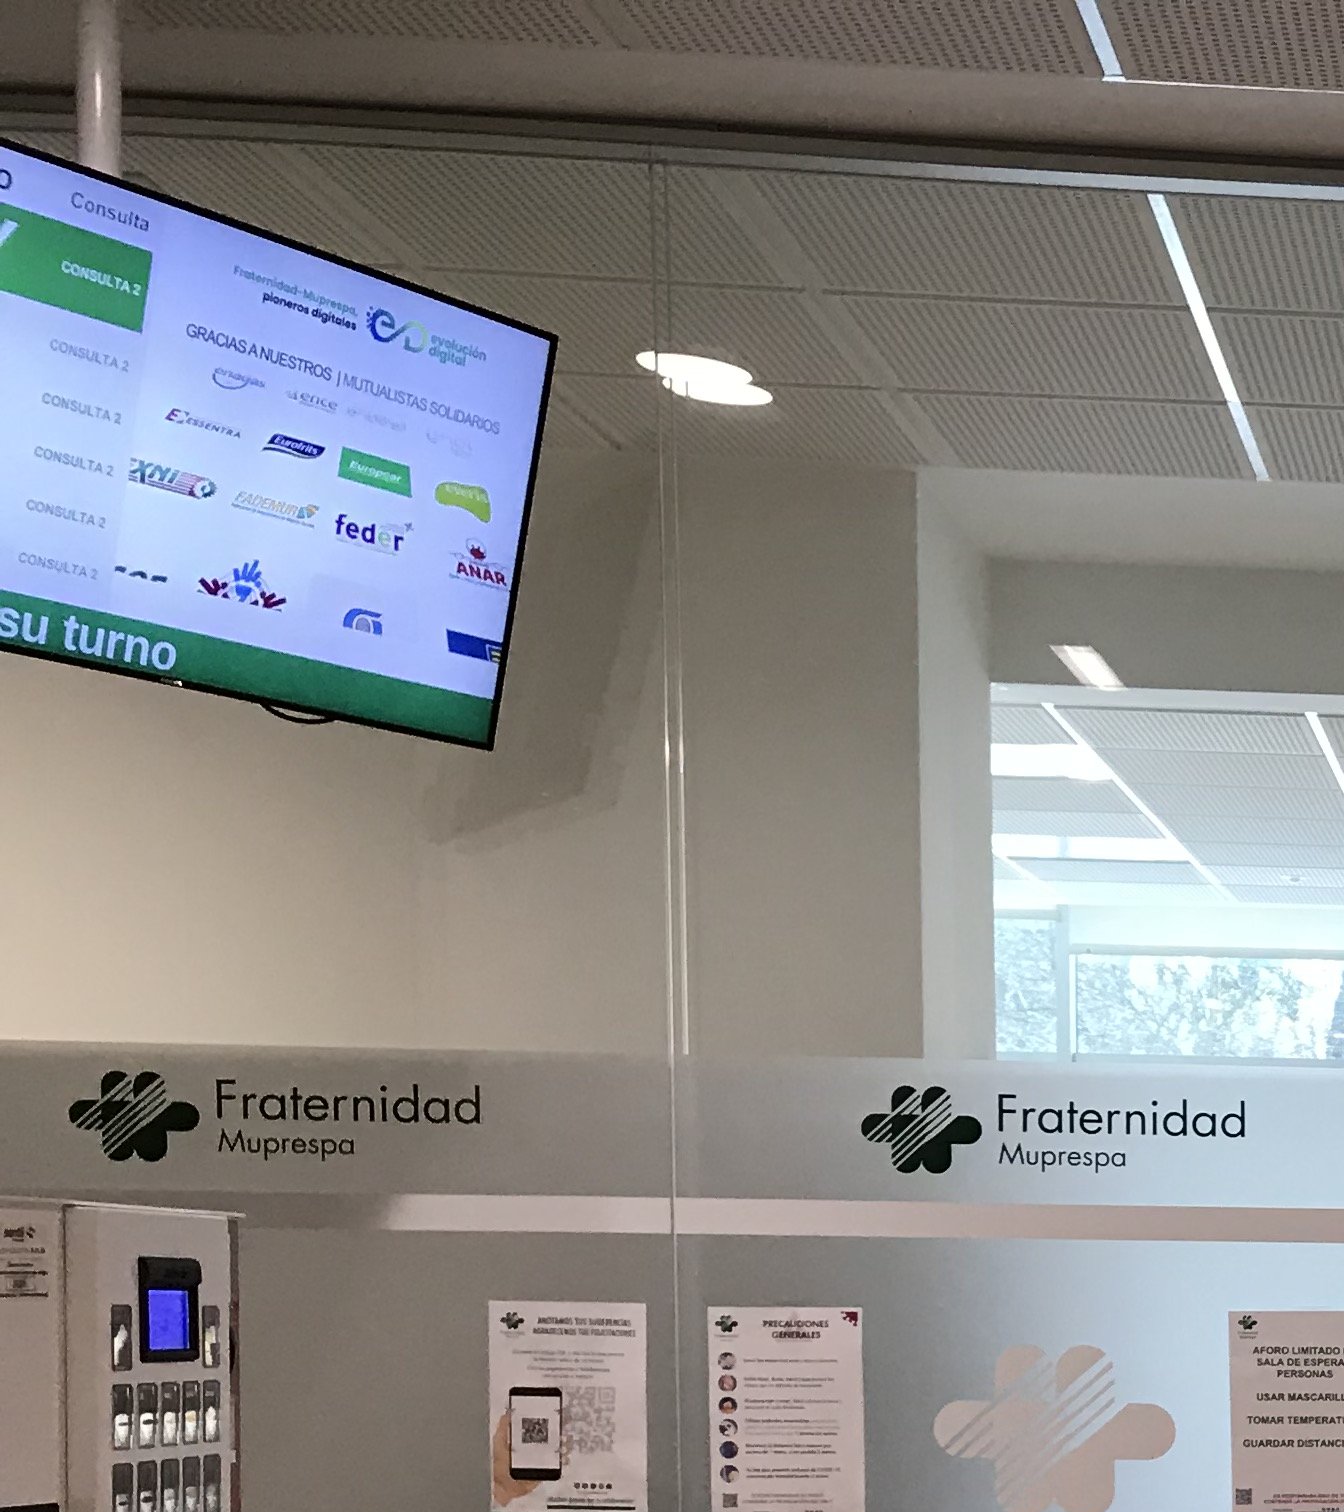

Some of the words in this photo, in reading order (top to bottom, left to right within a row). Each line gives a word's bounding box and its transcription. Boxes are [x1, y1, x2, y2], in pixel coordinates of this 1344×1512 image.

[71, 192, 149, 232] Consulta
[61, 260, 130, 293] CONSULTA
[132, 284, 141, 296] 2
[261, 291, 309, 316] pioneros
[311, 306, 357, 331] digitales
[50, 338, 118, 370] CONSULTA
[121, 360, 129, 373] 2
[429, 345, 467, 367] digital
[430, 333, 487, 362] evolución
[186, 323, 247, 355] GRACIAS
[247, 343, 258, 358] A
[259, 346, 332, 382] NUESTROS
[344, 373, 427, 413] MUTUALISTAS
[429, 401, 501, 436] SOLIDARIOS
[41, 392, 110, 423] CONSULTA
[114, 412, 122, 425] 2
[34, 445, 102, 475] CONSULTA
[105, 464, 114, 477] 2
[350, 459, 402, 484] Europcar
[26, 499, 94, 527] CONSULTA
[98, 516, 106, 529] 2
[335, 513, 404, 551] feder
[18, 551, 87, 579] CONSULTA
[90, 568, 98, 581] 2
[456, 561, 507, 587] ANAR
[0, 606, 49, 645] su
[63, 614, 177, 671] turno
[216, 1079, 482, 1125] Fraternidad
[997, 1094, 1247, 1139] Fraternidad
[218, 1129, 356, 1162] Muprespa
[998, 1142, 1127, 1173] Muprespa
[771, 1330, 821, 1340] GENERALES
[1252, 1346, 1290, 1355] AFORO
[1291, 1346, 1341, 1355] LIMITADO
[1256, 1358, 1285, 1367] SALA
[1286, 1358, 1301, 1367] DE
[1303, 1358, 1344, 1367] ESPERA
[1276, 1369, 1334, 1378] PERSONAS
[1256, 1392, 1286, 1401] USAR
[1247, 1415, 1285, 1425] TOMAR
[1242, 1439, 1295, 1448] GUARDAR
